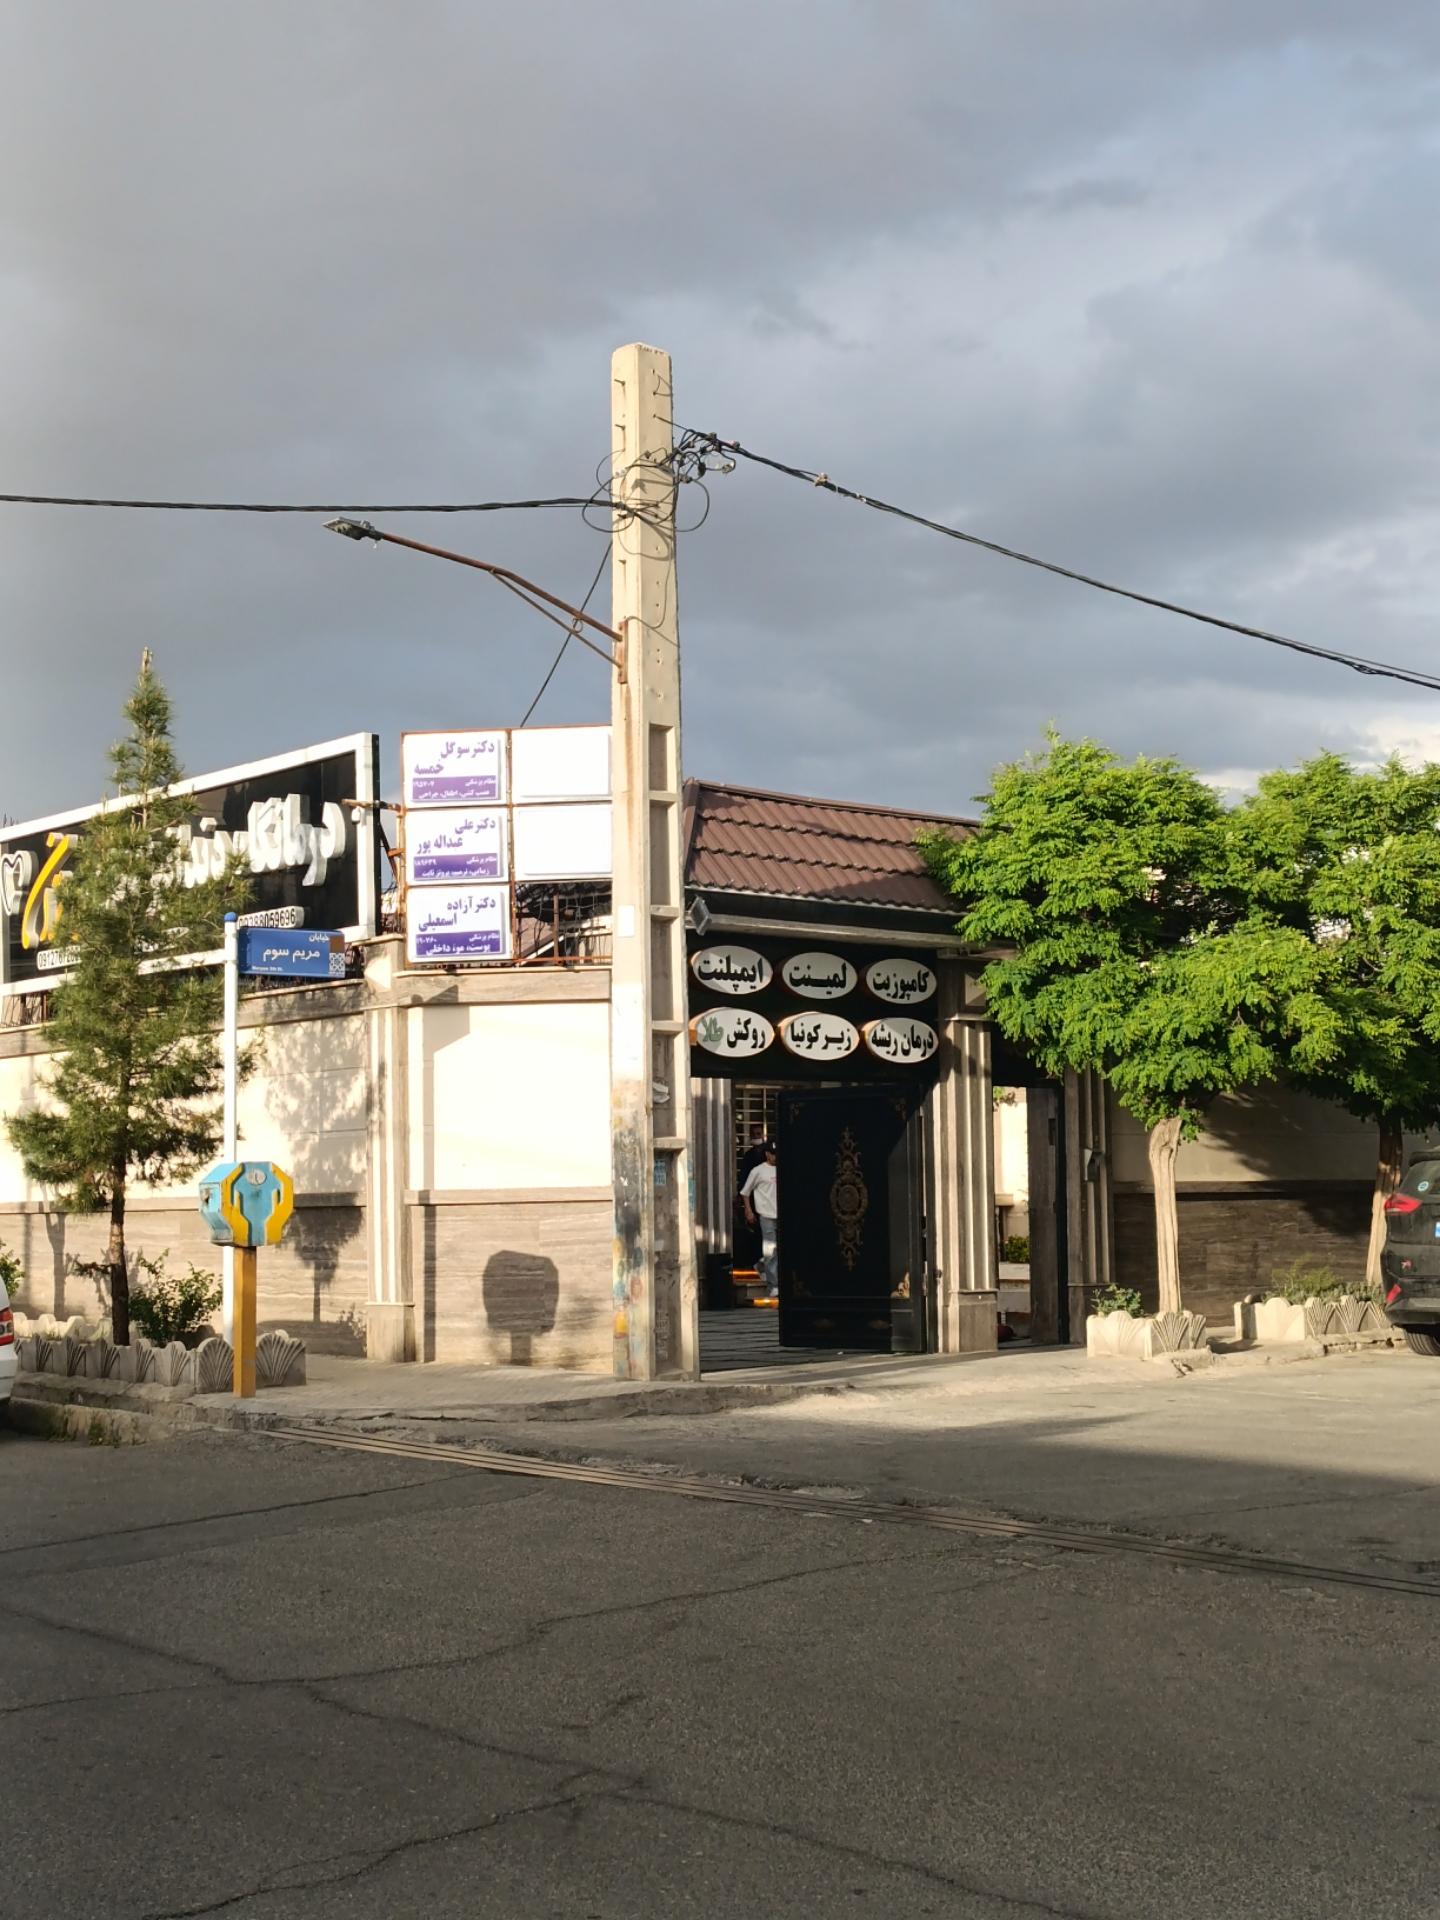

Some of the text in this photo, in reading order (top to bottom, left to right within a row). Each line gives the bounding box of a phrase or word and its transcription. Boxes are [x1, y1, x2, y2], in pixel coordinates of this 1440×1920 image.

[471, 740, 495, 759] دکتر
[454, 817, 496, 835] دکتر علی
[447, 896, 496, 914] دکتر آزاده
[308, 932, 330, 943] خیابان
[262, 948, 320, 963] مریم سوم
[698, 954, 764, 993] ایمپلنت
[789, 962, 847, 996] لمینت
[872, 969, 930, 1001] کامپوزیت
[700, 1015, 766, 1050] روکش طلا
[870, 1023, 934, 1058] درمان ریشه
